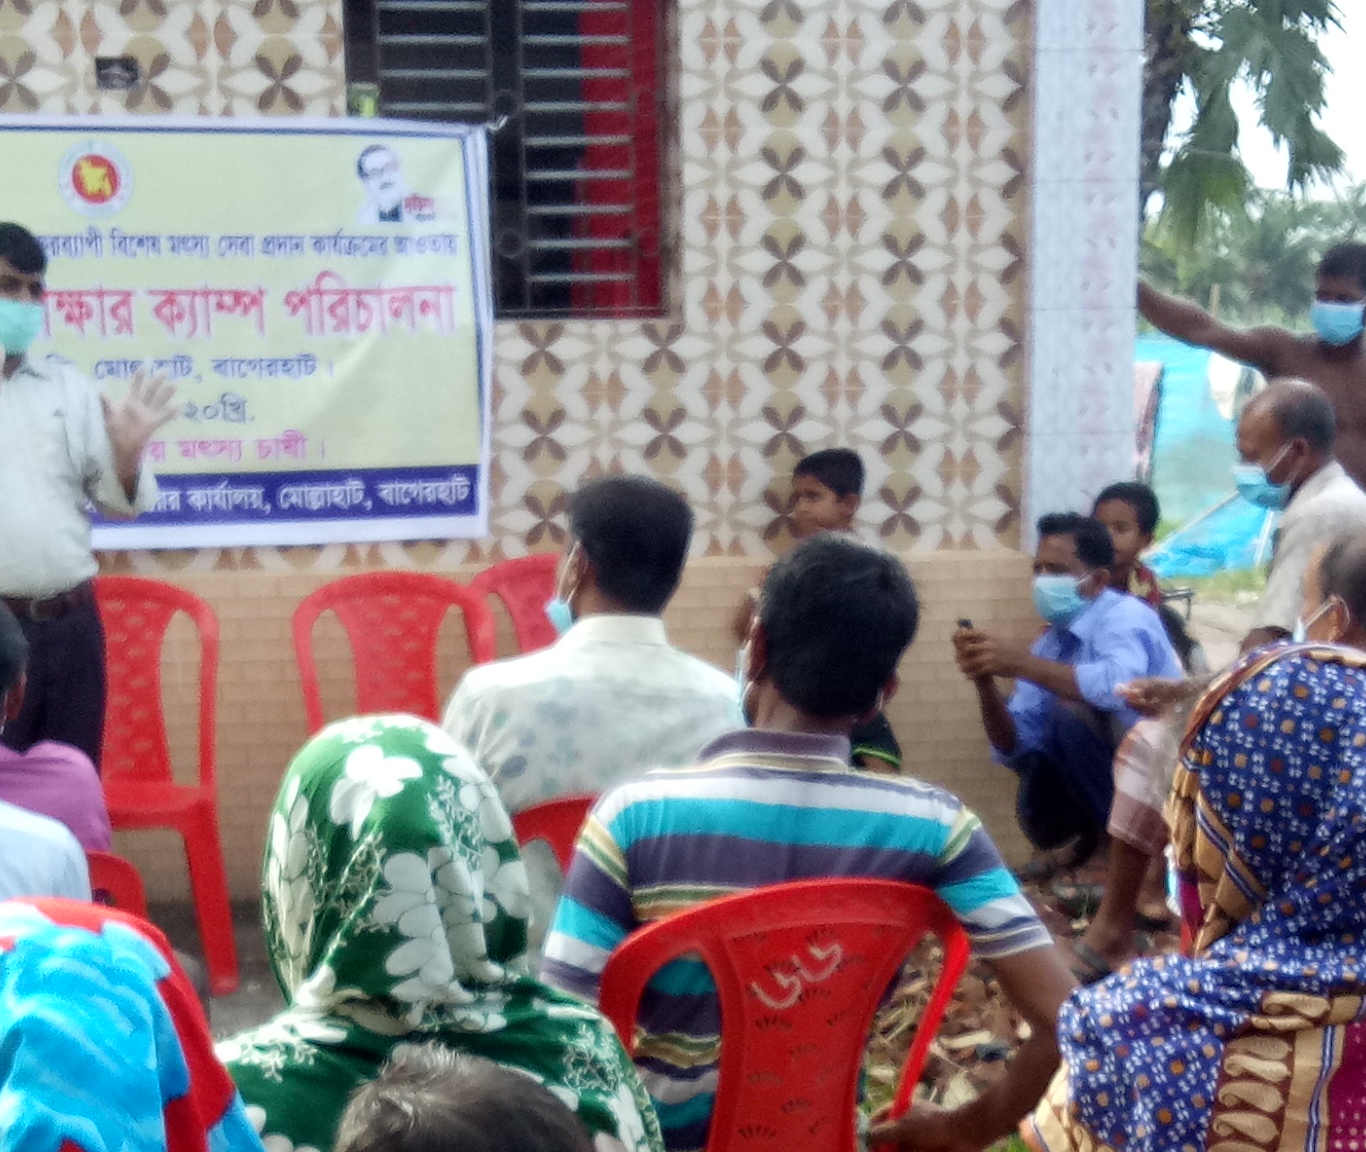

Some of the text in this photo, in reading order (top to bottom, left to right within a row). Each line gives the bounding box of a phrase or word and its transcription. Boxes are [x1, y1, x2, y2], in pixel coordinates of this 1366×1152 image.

[111, 228, 162, 257] বিশেষ
[219, 234, 255, 257] সেবা
[262, 234, 306, 256] প্রদান
[148, 283, 266, 338] ক্যাম্প
[283, 269, 456, 336] পরিচালনা
[376, 474, 471, 505] বাগেরহাট
